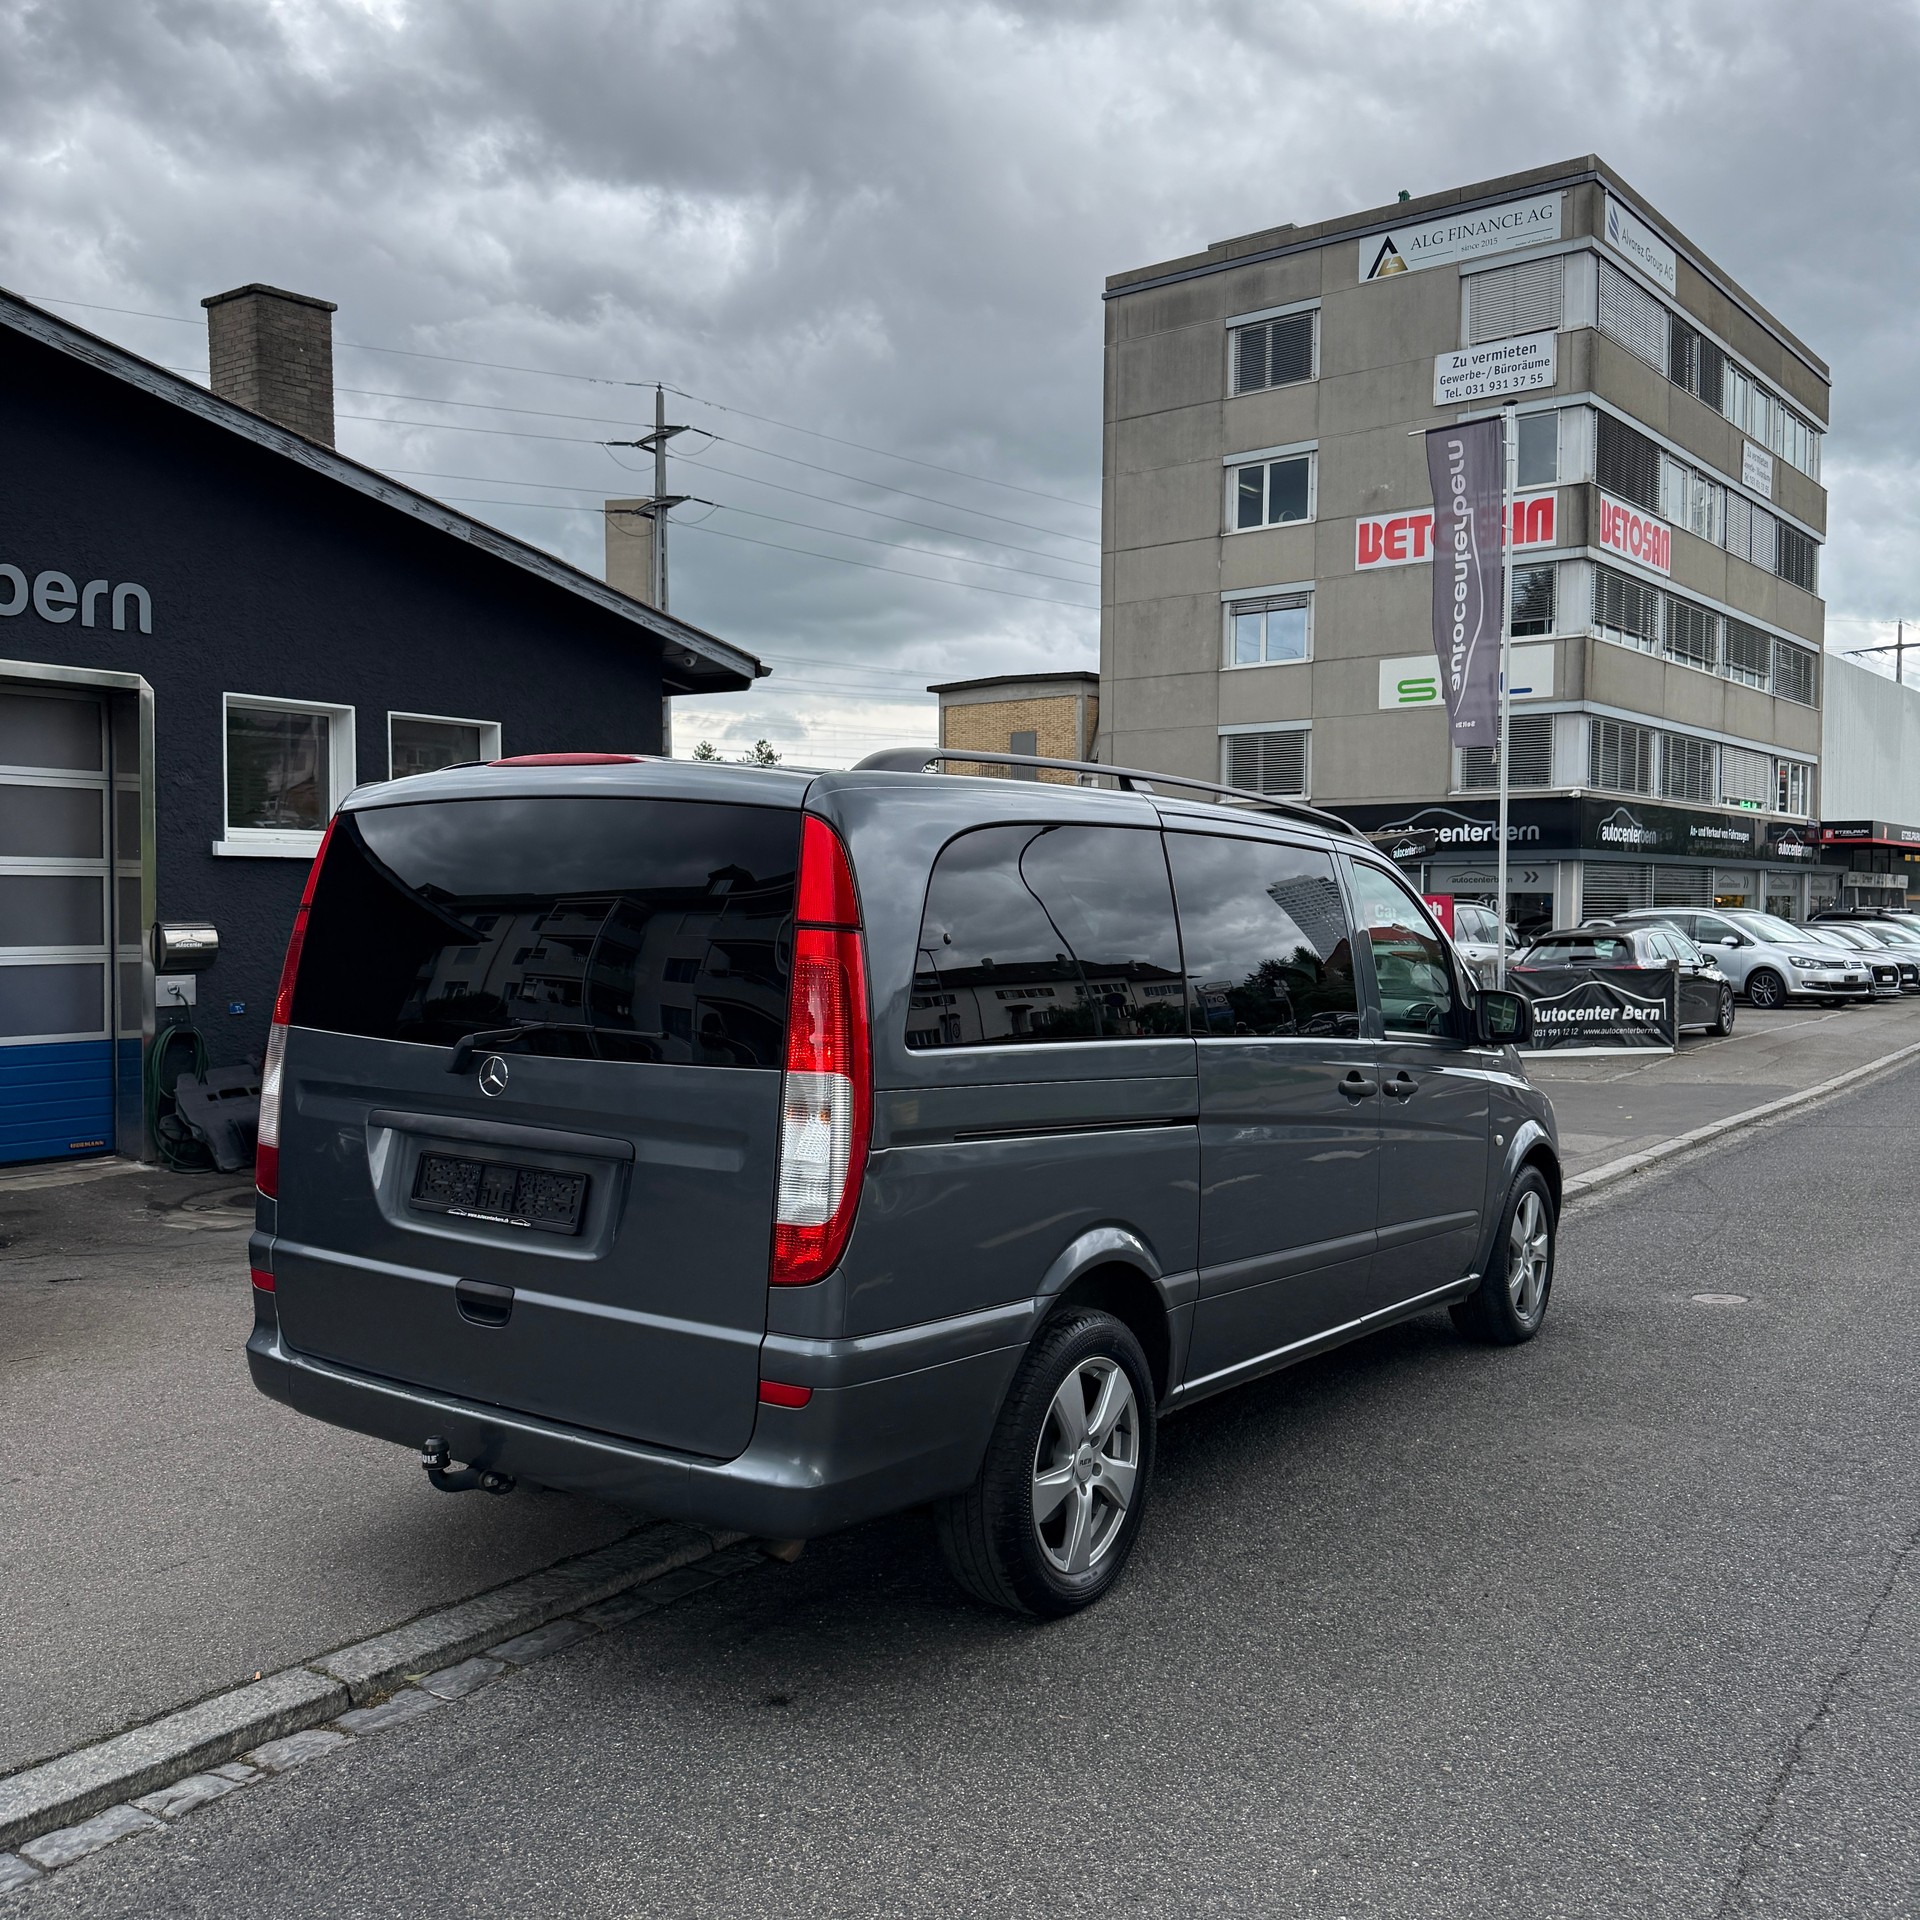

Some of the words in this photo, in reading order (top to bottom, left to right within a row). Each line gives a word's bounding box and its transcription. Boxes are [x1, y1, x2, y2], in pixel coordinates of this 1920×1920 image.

[1410, 231, 1444, 250] ALG
[1448, 212, 1523, 241] FINANCE
[1527, 205, 1553, 223] AG
[1481, 237, 1498, 249] 2015
[1452, 356, 1467, 368] Zu
[1472, 344, 1537, 365] vermieten
[1494, 358, 1550, 375] Büroräume
[1445, 388, 1462, 399] Tel.
[1465, 384, 1485, 395] 031
[1489, 379, 1508, 391] 931
[1513, 376, 1526, 387] 37
[1530, 373, 1544, 384] 55
[1600, 498, 1670, 571] BETOSAN
[1622, 1005, 1660, 1021] Bern
[1548, 1029, 1560, 1037] 991
